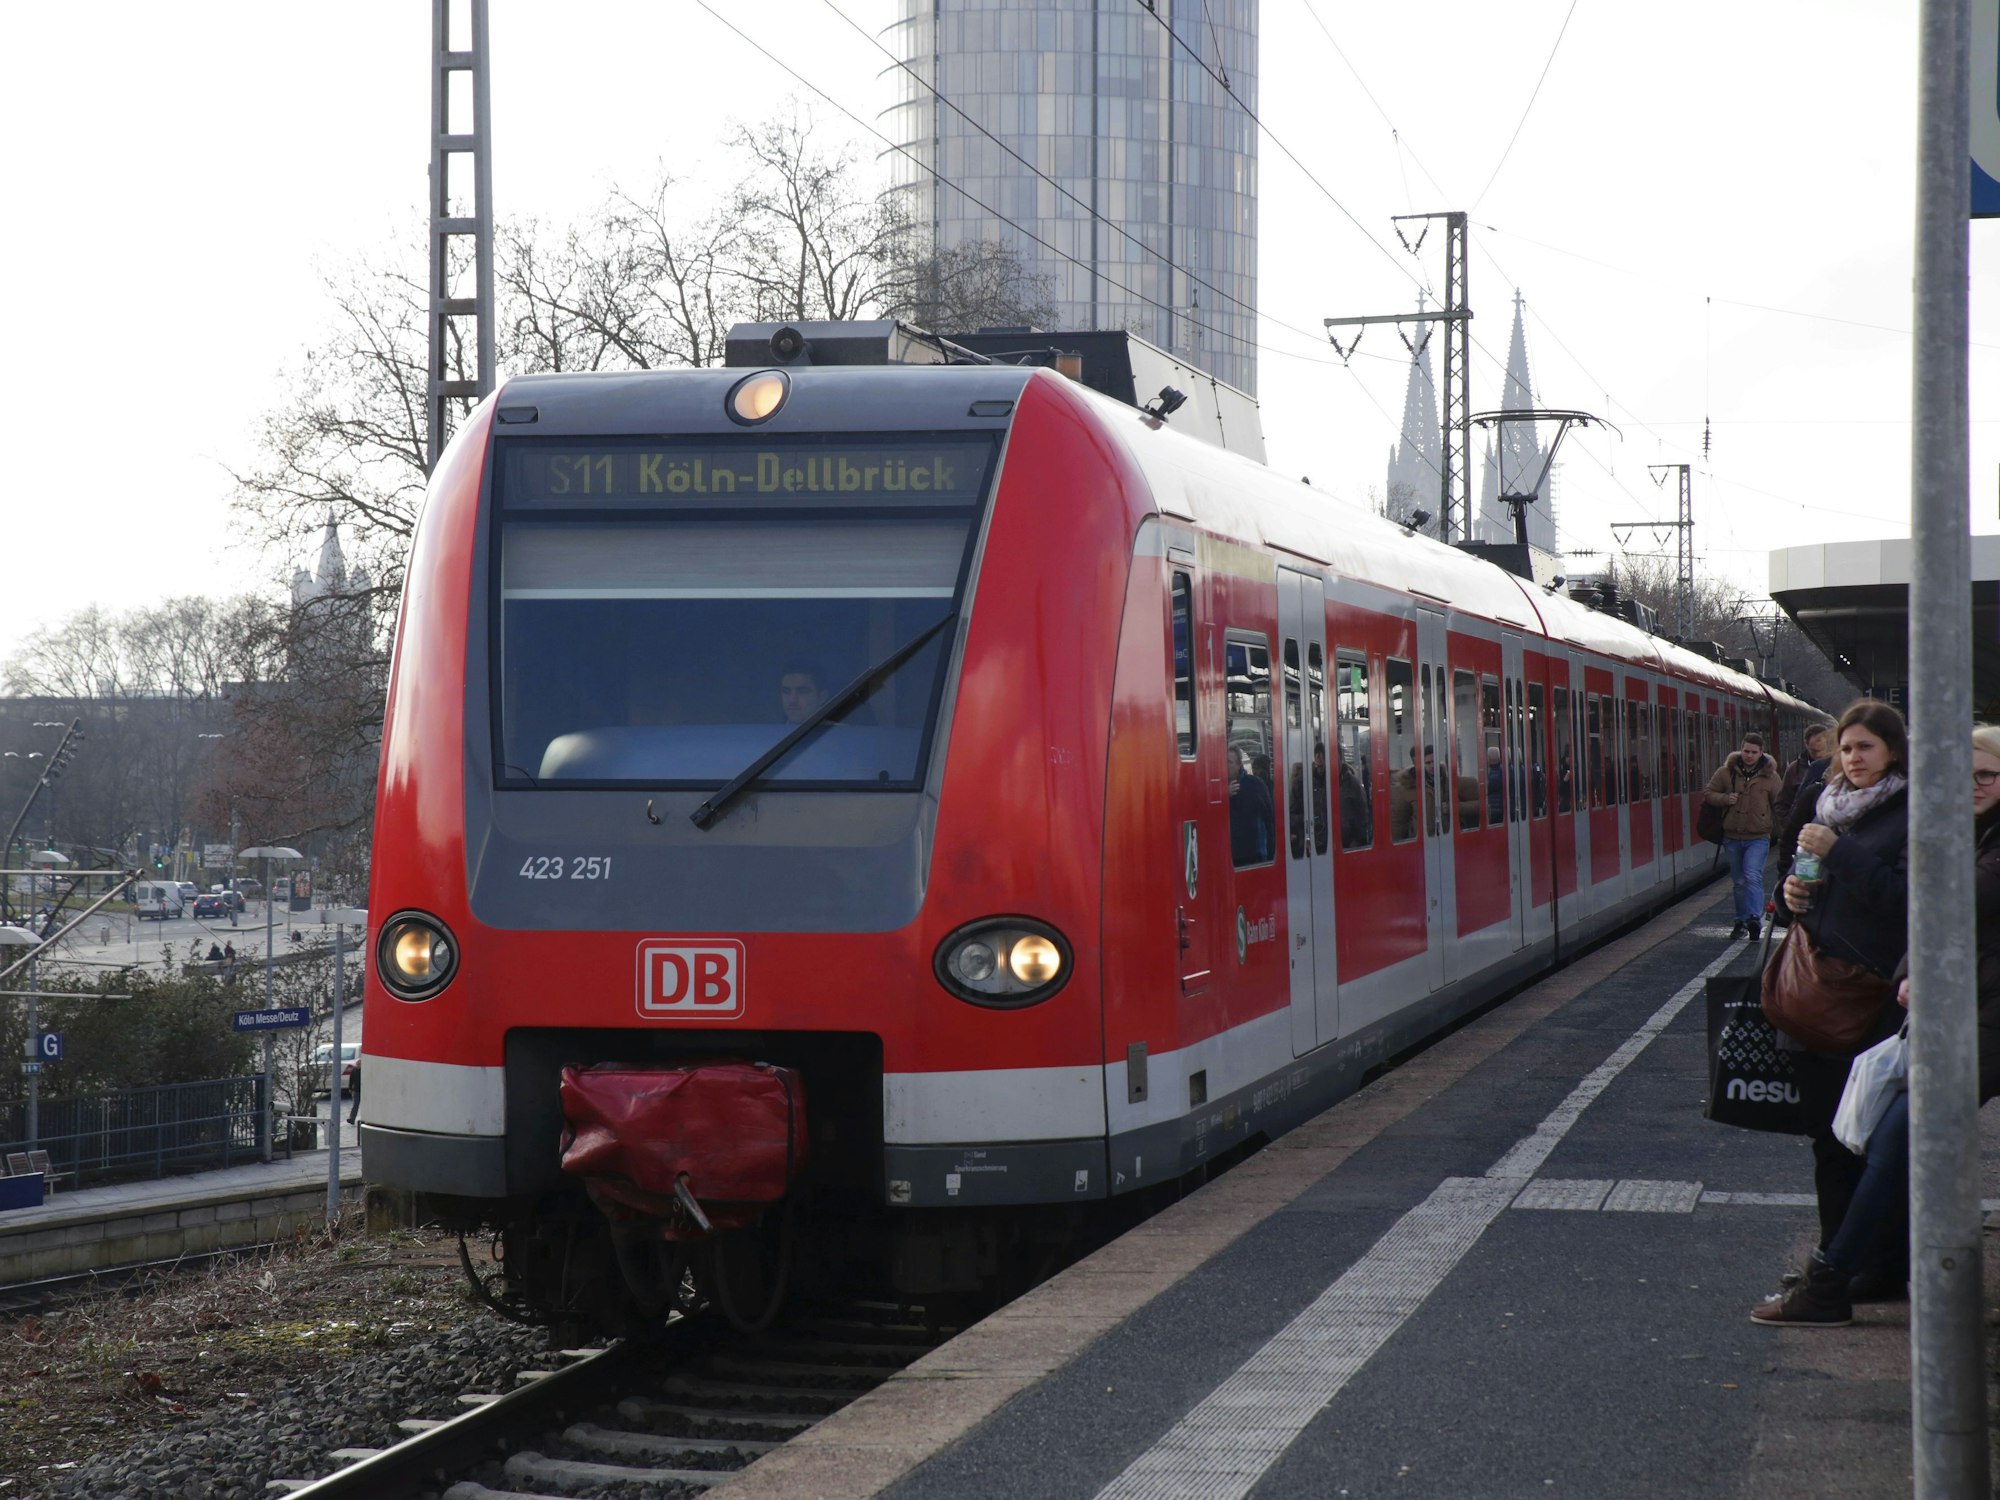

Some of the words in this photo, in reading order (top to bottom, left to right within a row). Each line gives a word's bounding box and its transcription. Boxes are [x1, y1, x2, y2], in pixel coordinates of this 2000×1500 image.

[549, 453, 613, 494] S11
[639, 451, 956, 494] Köln-Dellbrück
[1889, 687, 1901, 704] E
[519, 856, 564, 880] 423
[570, 856, 612, 880] 251
[651, 952, 732, 1005] DB
[238, 1014, 255, 1026] Köln
[255, 1011, 299, 1025] Messe/Deutz
[43, 1033, 58, 1056] G
